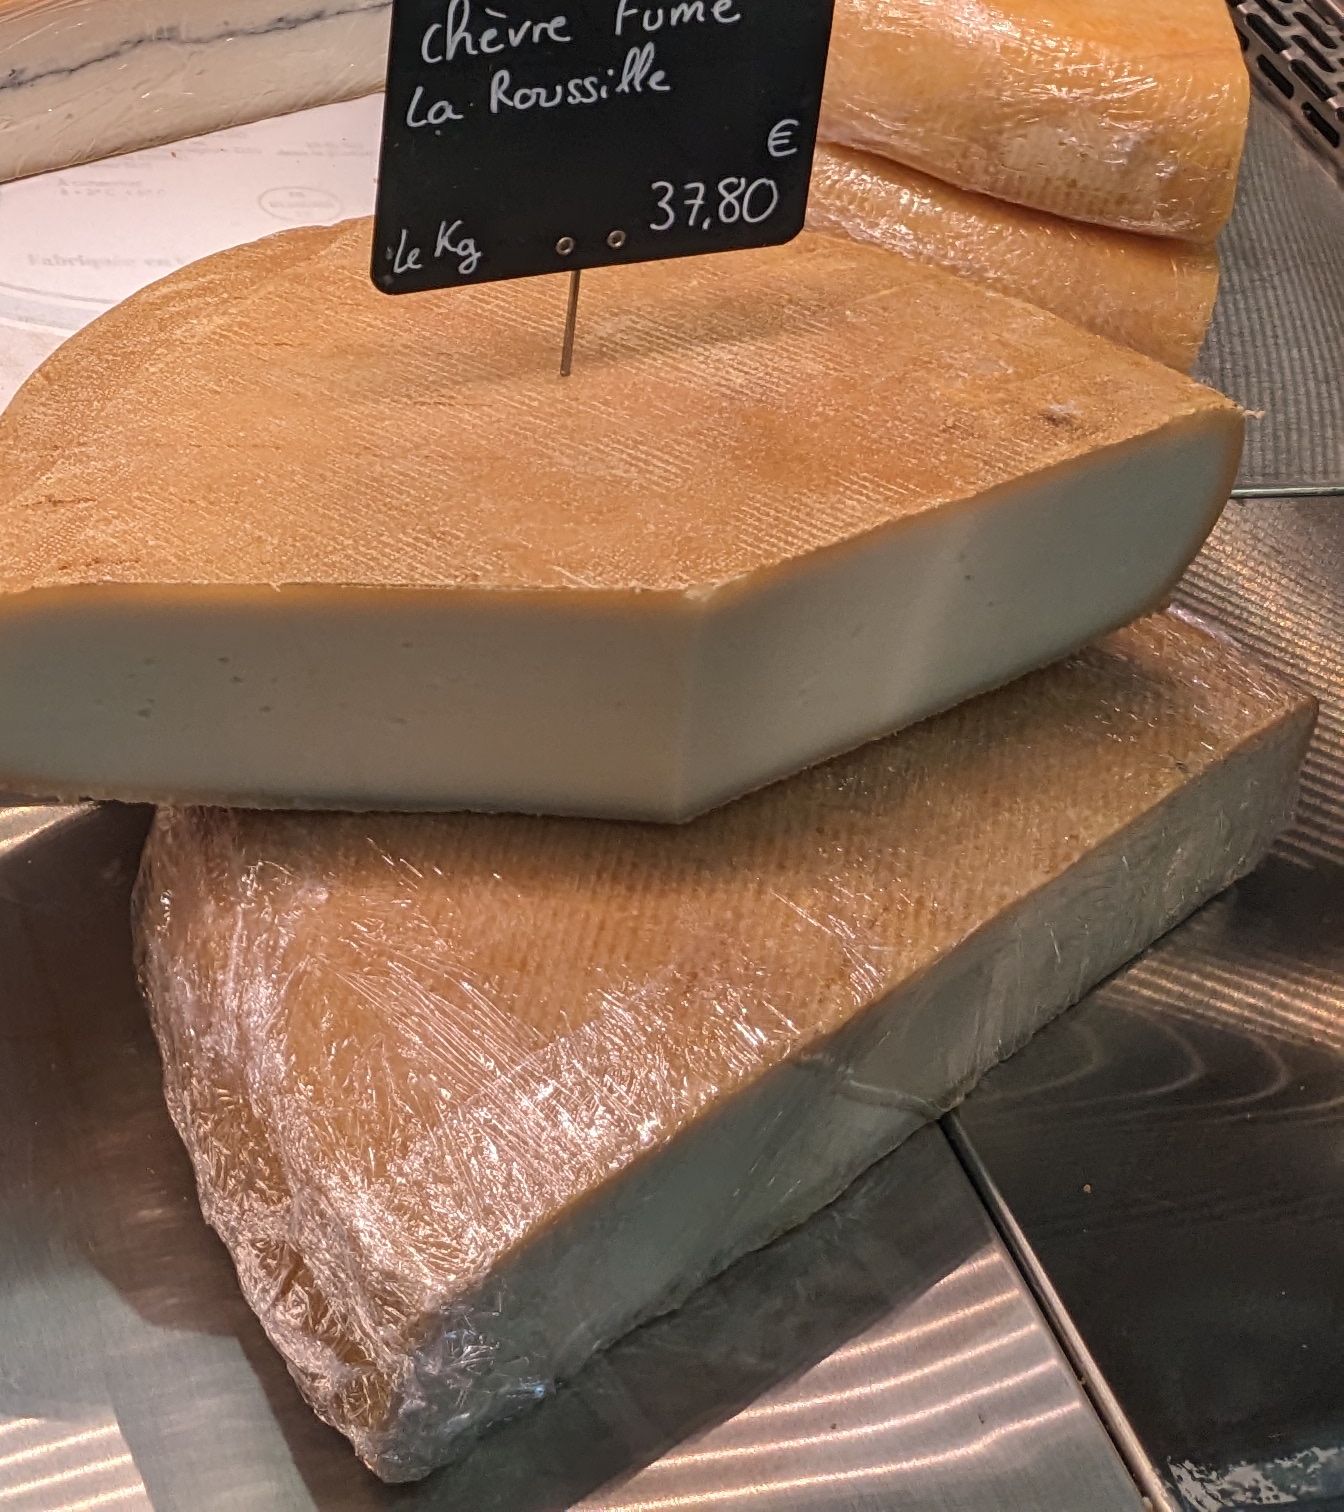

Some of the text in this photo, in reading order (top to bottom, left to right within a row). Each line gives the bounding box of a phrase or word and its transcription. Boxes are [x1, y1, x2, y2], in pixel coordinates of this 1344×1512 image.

[406, 41, 671, 129] La Roussille
[767, 118, 800, 158] €
[434, 219, 482, 275] Kg
[649, 176, 779, 231] 37,80
